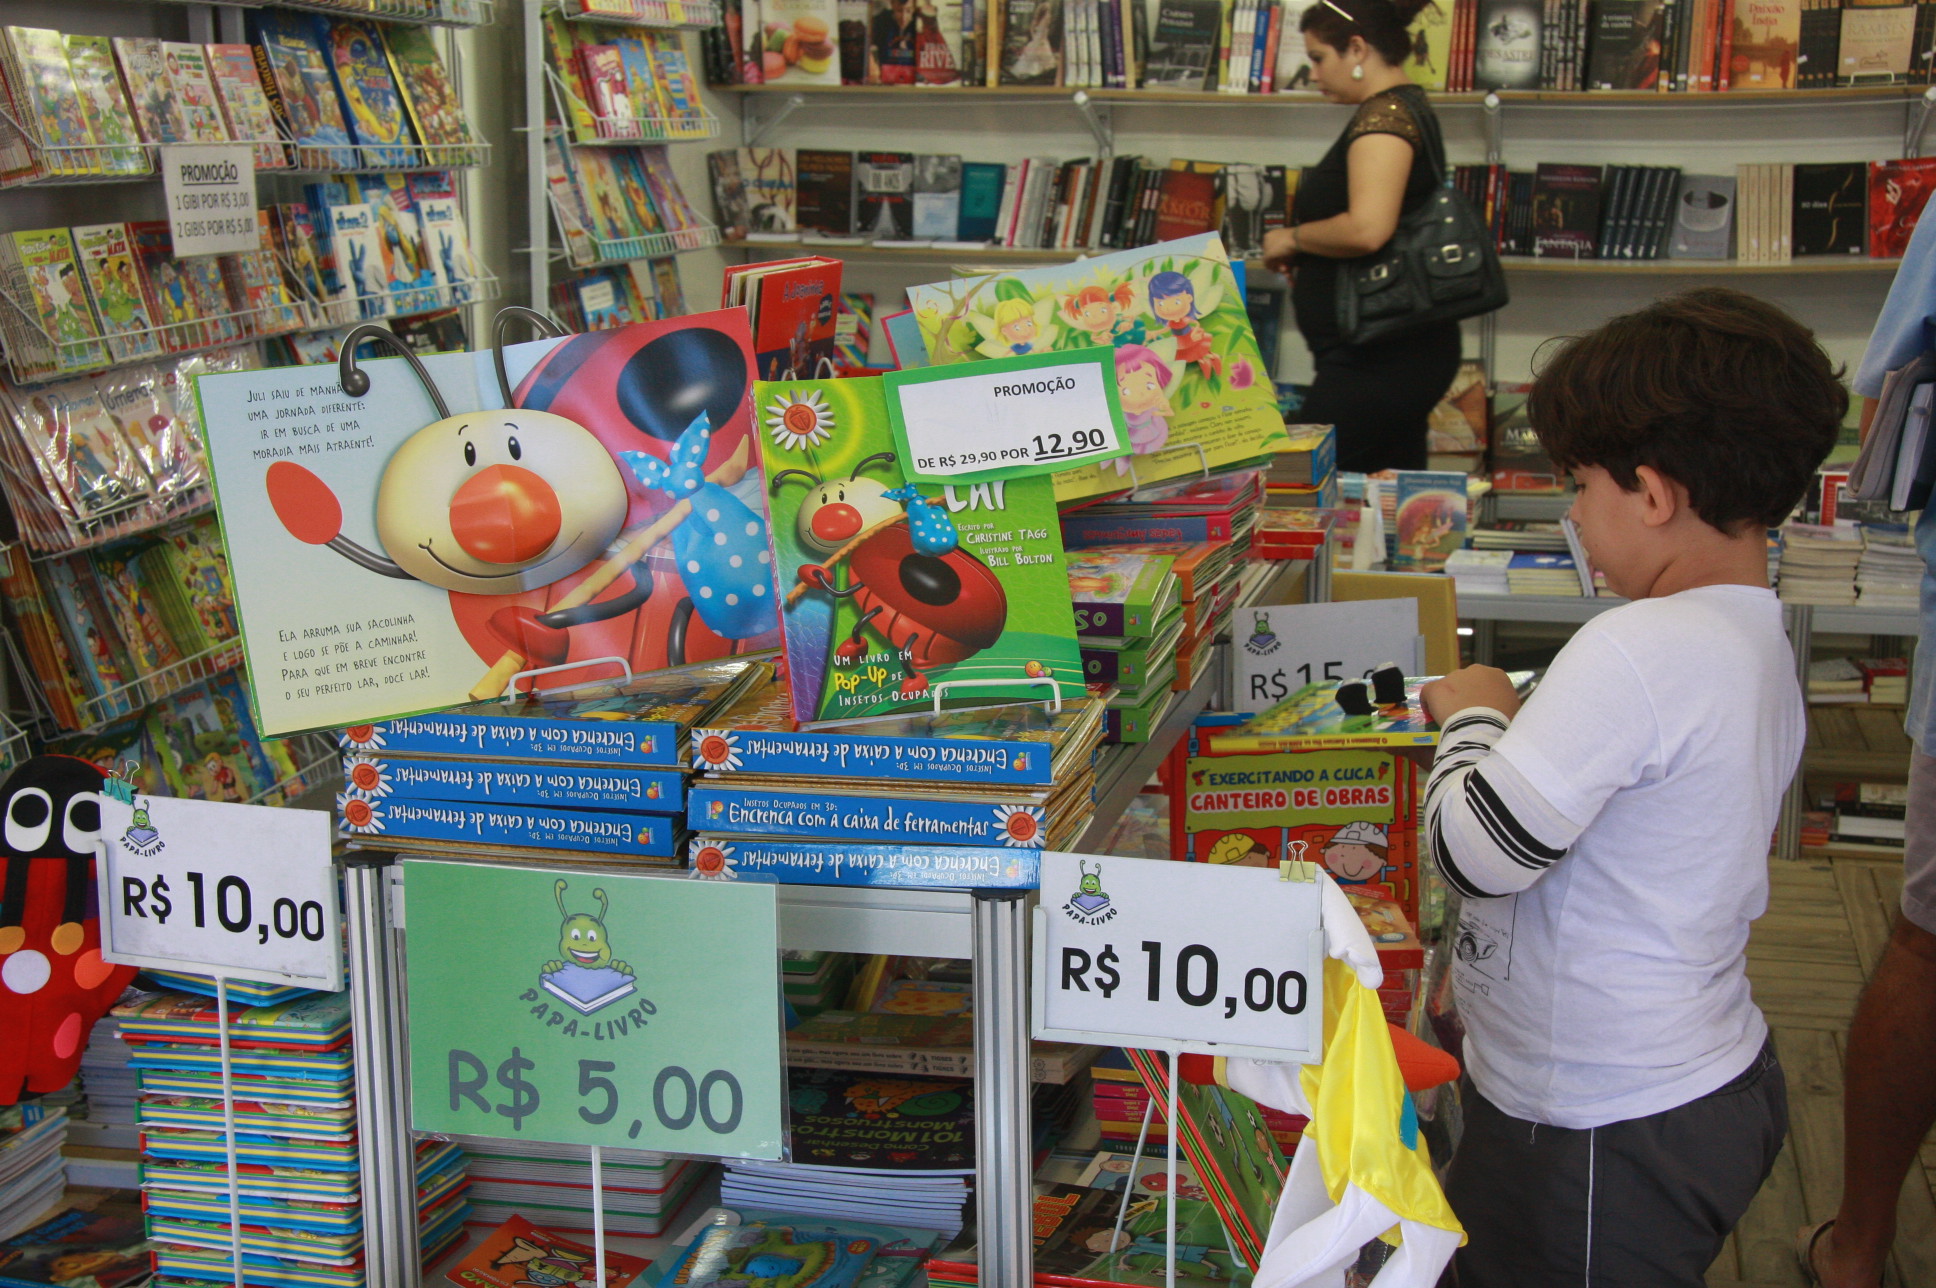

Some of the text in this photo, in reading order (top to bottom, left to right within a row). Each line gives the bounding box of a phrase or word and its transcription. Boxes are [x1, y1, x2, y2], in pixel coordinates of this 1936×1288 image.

[181, 160, 238, 184] PROMOÇÃO
[176, 192, 249, 210] 1 GIBI POR R$ 3,00
[177, 218, 254, 238] 2 GIBIS POR R$ 5,00
[247, 390, 266, 402] JULI
[271, 389, 290, 400] SAIU
[296, 387, 305, 397] DE
[993, 376, 1077, 398] PROMOÇÃO
[248, 401, 366, 421] UMA JORNADA DIFERENTE:
[261, 420, 361, 440] IR EM BUSCA DE UMA
[253, 435, 375, 460] MORADIA MAIS ATRAENTE!
[917, 428, 1107, 469] DE R$ 29,90 POR 12,90
[957, 522, 994, 532] ESCRITO POR
[966, 529, 1047, 544] CHRISTINE TAGG
[979, 546, 1009, 555] ILUSTRADO
[988, 552, 1053, 567] BILL BOLTON
[278, 613, 415, 642] ELA ARRUMA SUA SACOLINHA
[283, 630, 419, 662] E LOGO SE PÕE A CAMINHAR!
[1243, 641, 1282, 656] PAPA-LIVRO
[281, 650, 426, 681] PARA QUE EM BREVE ENCONTRE
[834, 651, 913, 666] UM LIVRO EM
[285, 666, 430, 700] O SEU PERFEITO LAR, DOCE LAR!
[891, 671, 903, 681] DE
[1251, 668, 1288, 703] R$
[839, 694, 883, 707] INSETOS
[1209, 767, 1375, 787] EXERCITANDO A CUCA
[1190, 787, 1391, 812] CANTEIRO DE OBRAS
[120, 836, 166, 857] PAPA-LIVRO
[123, 871, 325, 945] R$ 10,00
[1062, 903, 1118, 926] PAPA-LIVRO
[1061, 940, 1307, 1019] R$ 10,00
[519, 987, 658, 1041] PAPA-LIVRO
[449, 1046, 744, 1140] R$ 5,00
[804, 1115, 956, 1130] Monstruosos
[803, 1139, 880, 1149] Desenhar
[920, 1131, 963, 1143] 101
